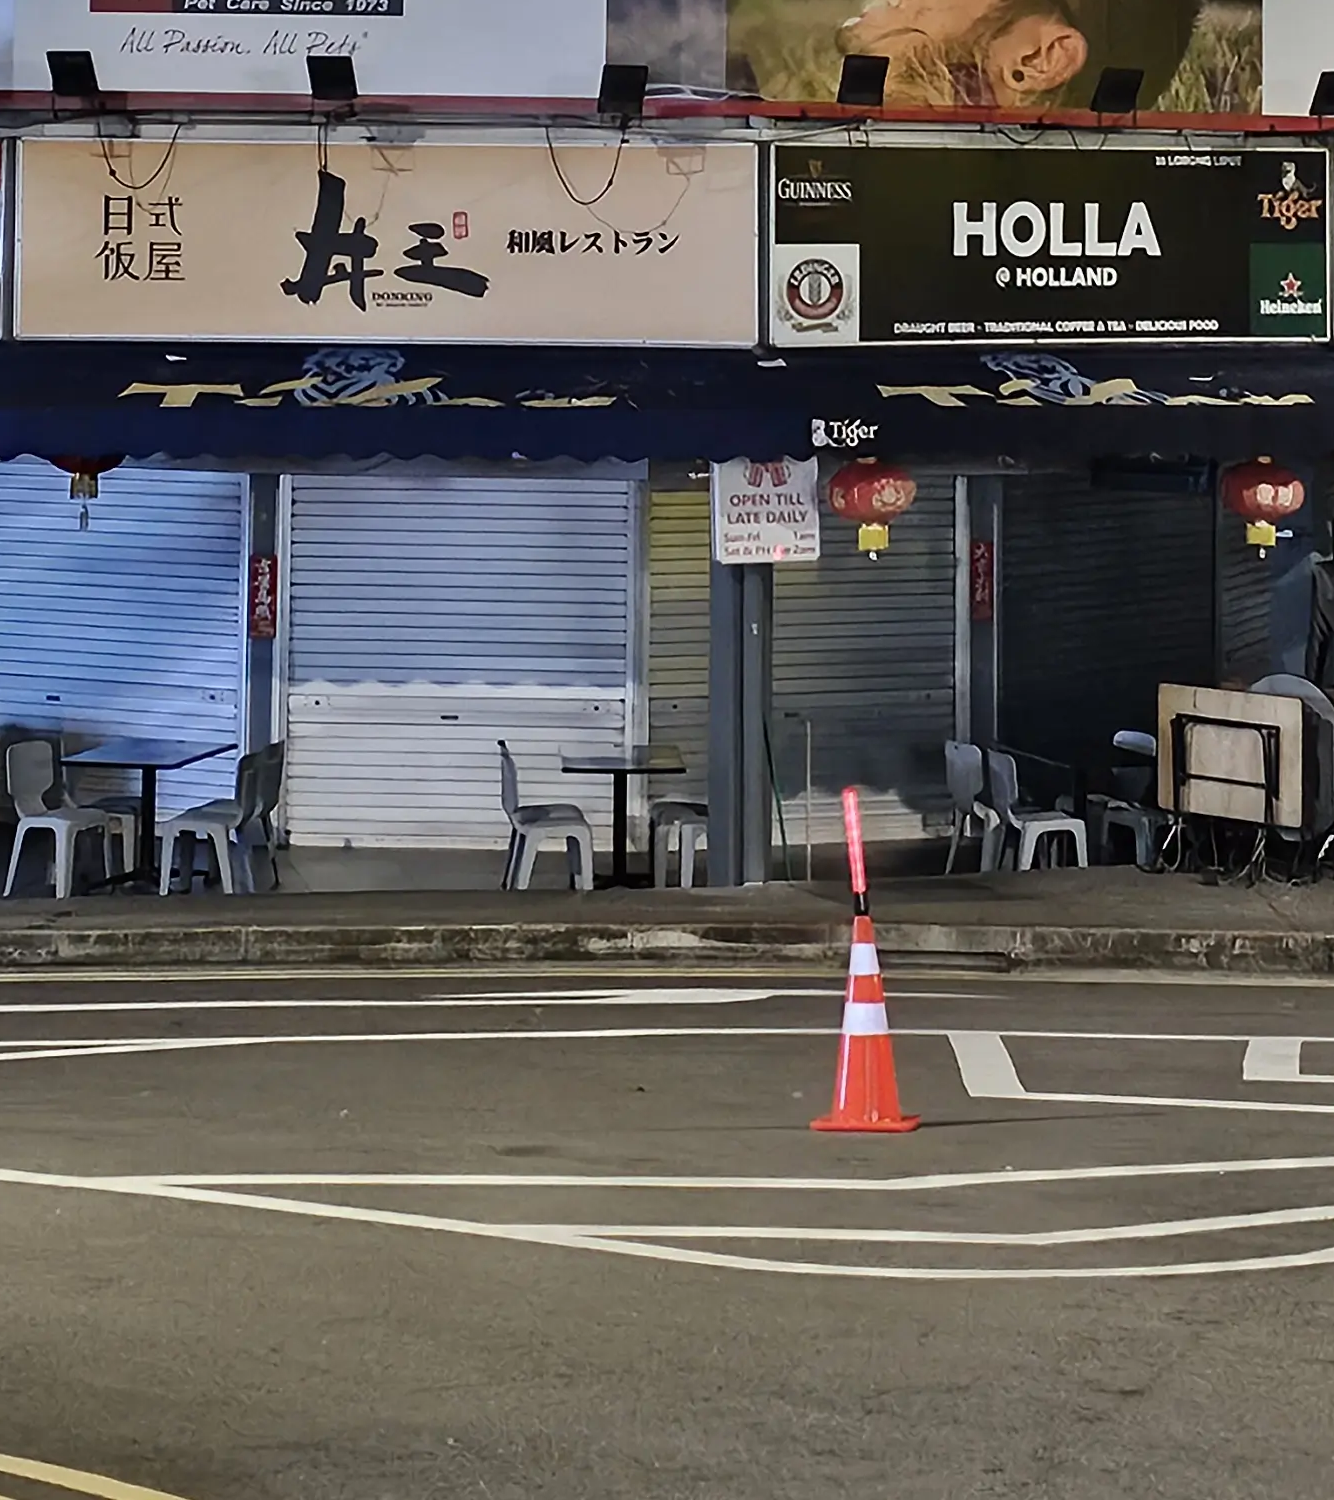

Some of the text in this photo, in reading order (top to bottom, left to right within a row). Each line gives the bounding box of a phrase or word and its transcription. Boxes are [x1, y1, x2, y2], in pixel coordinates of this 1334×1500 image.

[778, 177, 853, 202] GUINNESS
[104, 195, 184, 236] 日式
[1257, 190, 1323, 230] Tiger
[952, 201, 1162, 257] HOLLA
[996, 266, 1118, 289] @ HOLLAND
[1260, 299, 1323, 315] Heineken
[829, 418, 879, 447] Tiger
[729, 492, 805, 507] OPEN TILL
[727, 510, 808, 524] LATE DAILY
